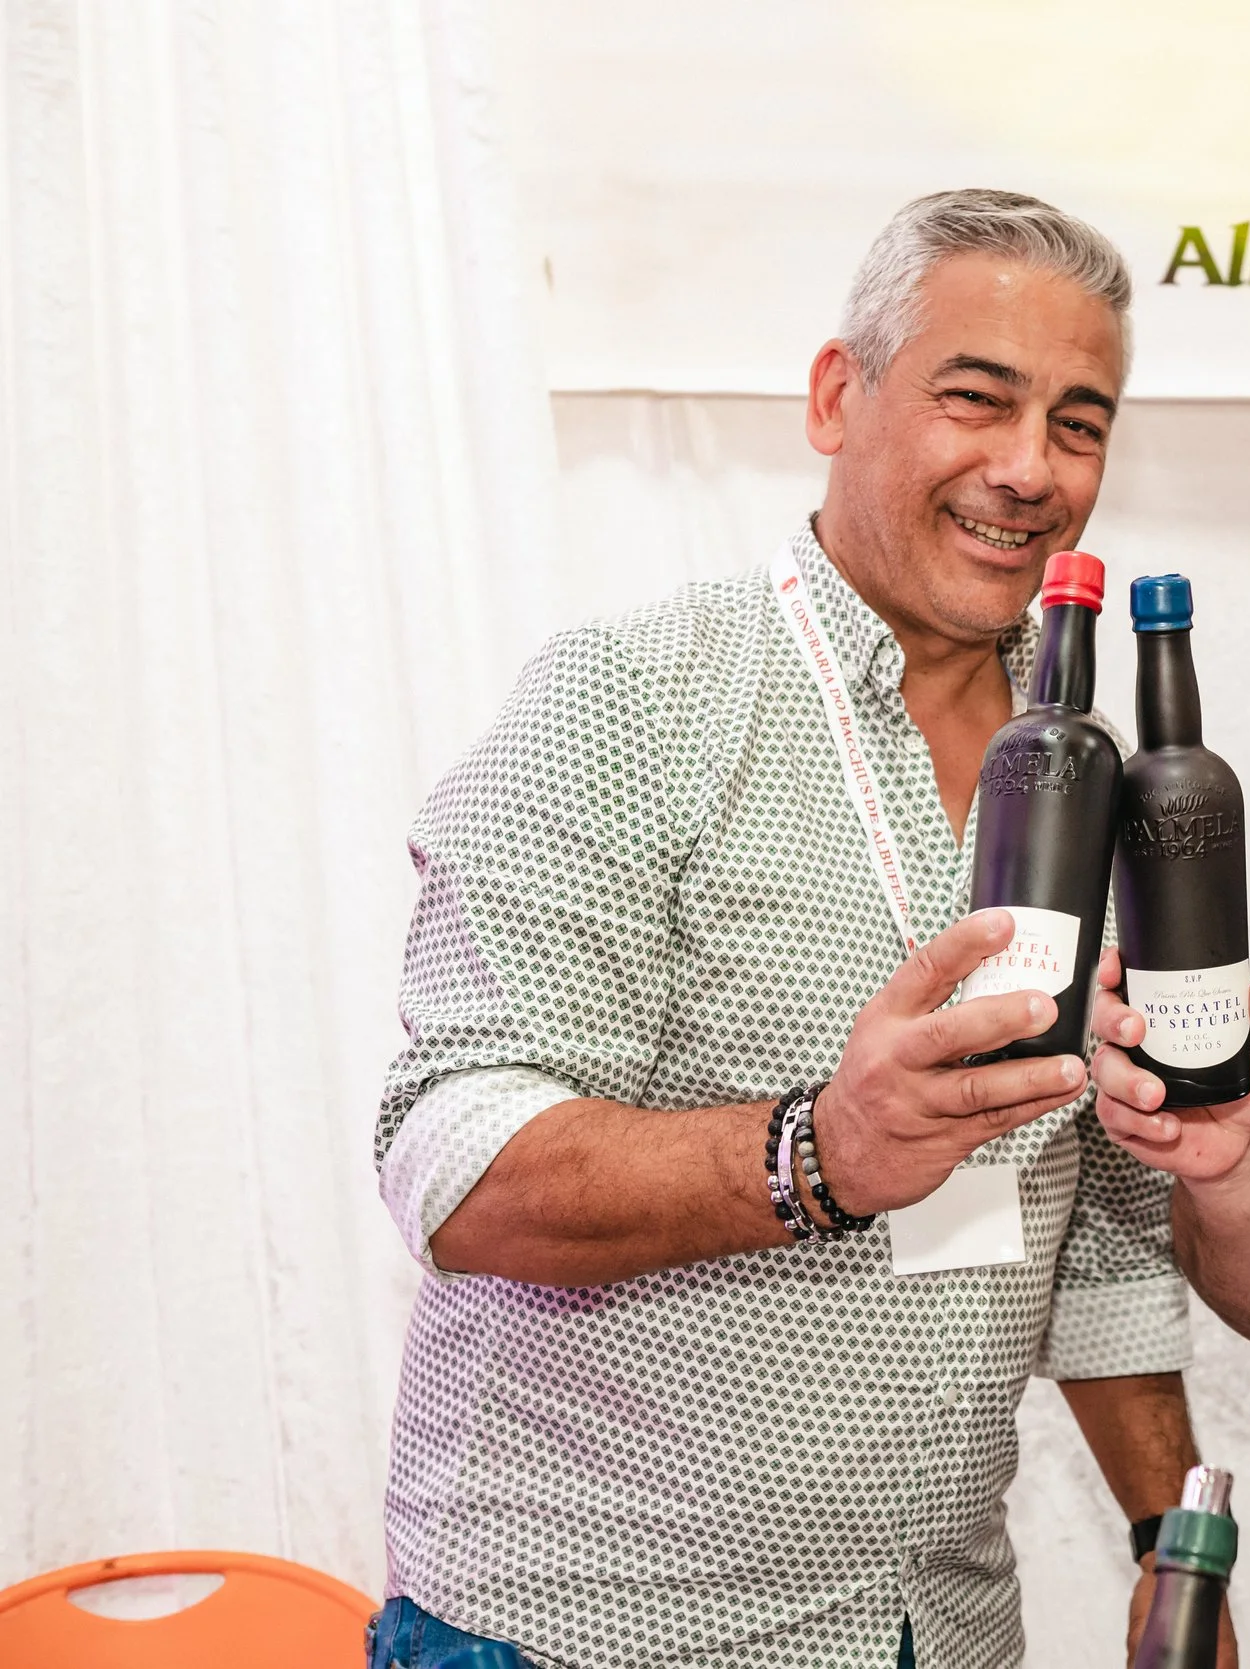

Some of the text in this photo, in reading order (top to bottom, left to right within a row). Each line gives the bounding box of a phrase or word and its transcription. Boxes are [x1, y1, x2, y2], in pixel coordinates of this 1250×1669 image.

[791, 600, 909, 923] CONFRARIA DO BACCHUS DE ALBUFEIRA
[1124, 810, 1240, 842] PALMELA
[1160, 835, 1206, 861] 1964
[982, 954, 1060, 972] ETÚBAL
[1145, 996, 1241, 1015] MOSCATEL
[1149, 1009, 1247, 1029] E SETÚBAL
[1172, 1040, 1222, 1052] 5 ANOS
